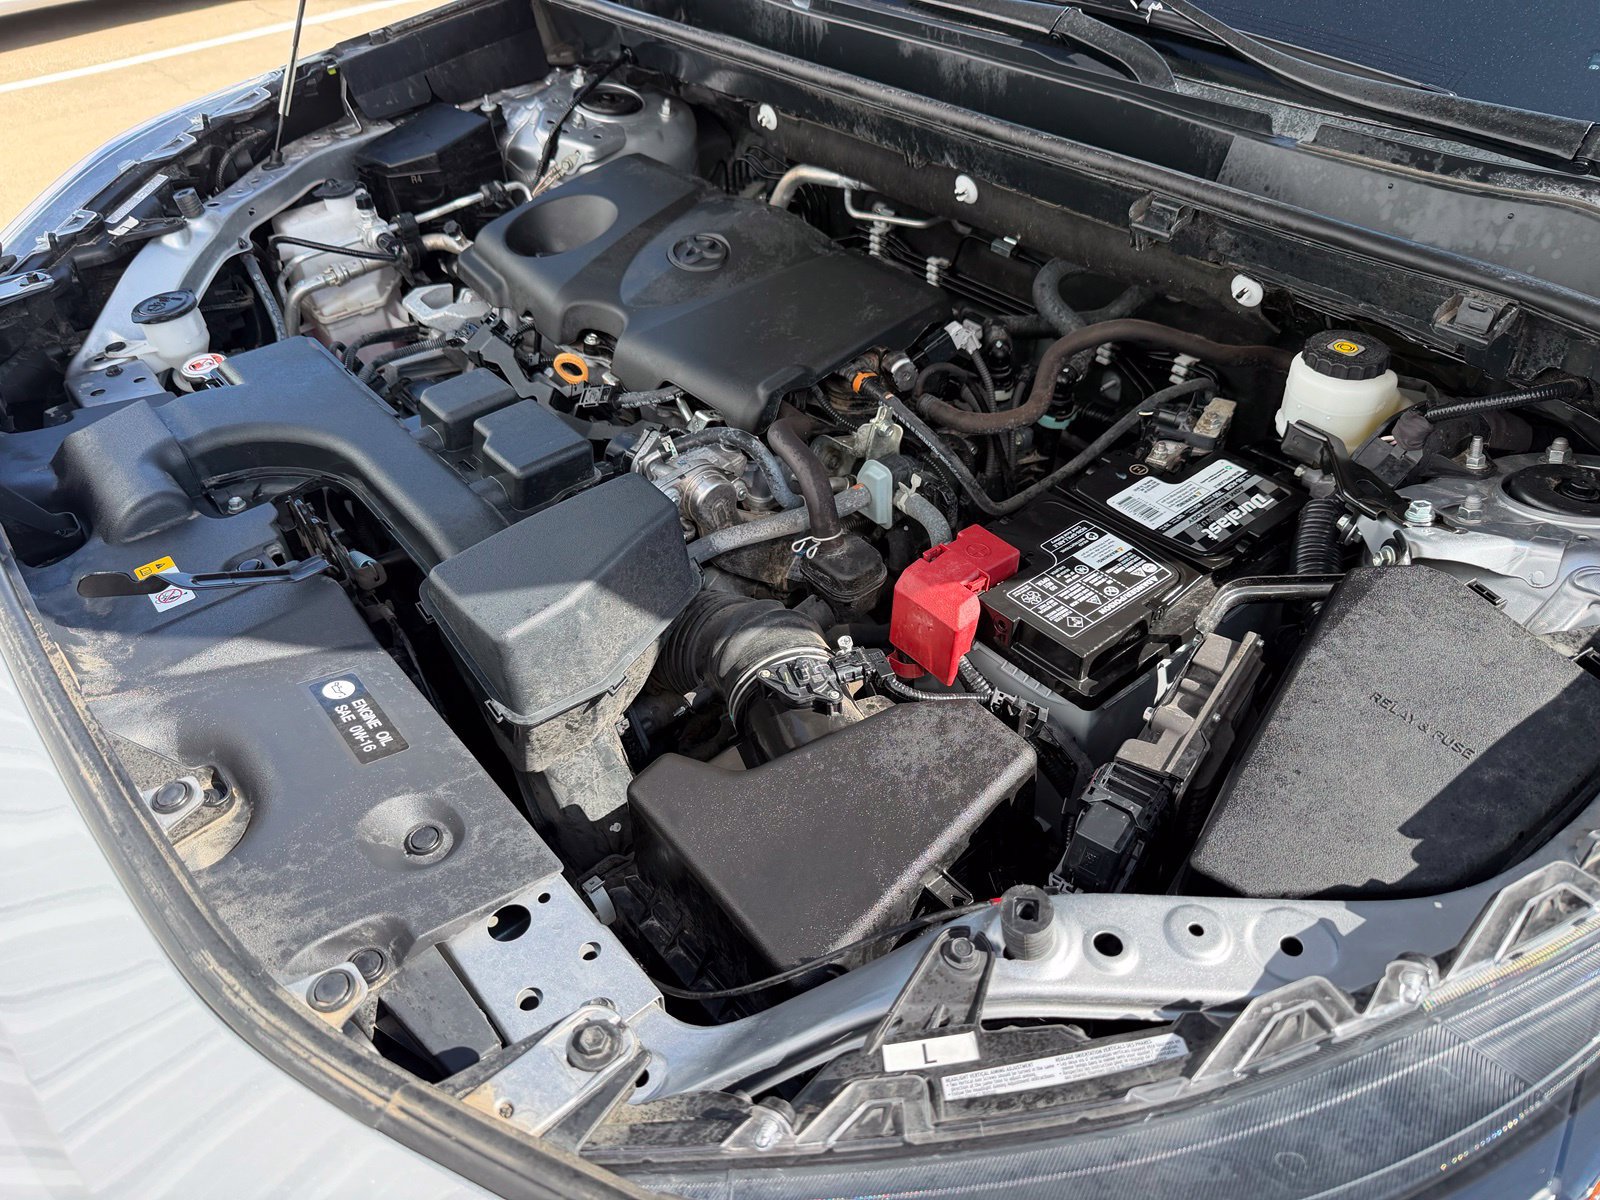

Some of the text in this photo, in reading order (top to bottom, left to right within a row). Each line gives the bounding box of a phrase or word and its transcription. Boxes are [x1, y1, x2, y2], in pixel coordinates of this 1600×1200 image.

[1186, 496, 1230, 523] TECHNOLOGY
[1198, 492, 1275, 541] Duralast
[1097, 578, 1154, 614] DANGER/POISON
[334, 704, 376, 752] SAE 0W-16
[351, 698, 394, 747] ENGINE OIL
[1370, 692, 1476, 760] RELAY & FUSE
[922, 1044, 937, 1064] L
[1006, 1062, 1033, 1071] ADJUSTMENT
